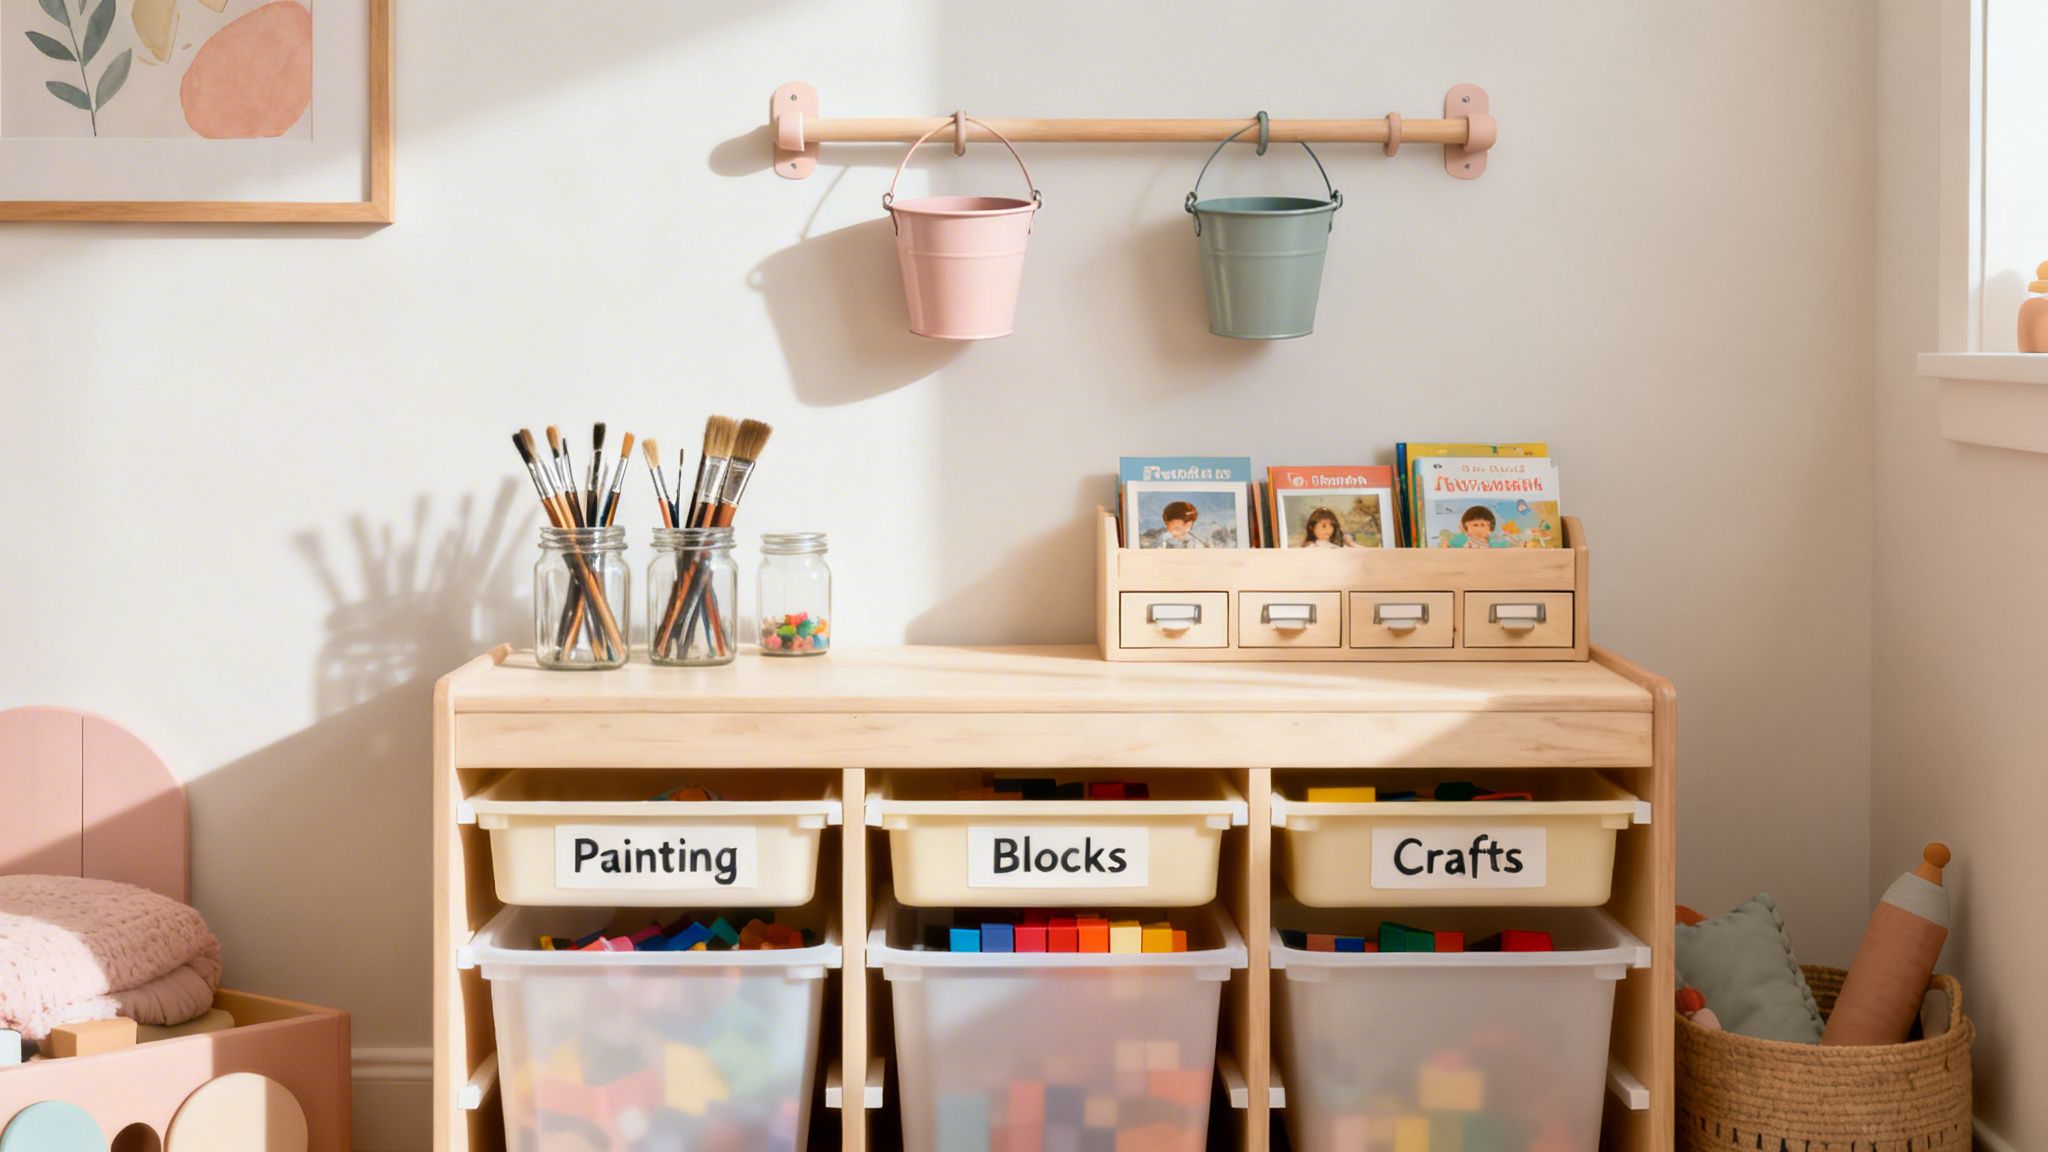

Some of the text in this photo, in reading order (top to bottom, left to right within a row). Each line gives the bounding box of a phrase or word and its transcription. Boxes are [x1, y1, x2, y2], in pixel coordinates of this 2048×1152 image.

[574, 836, 739, 886] Painting
[993, 835, 1127, 875] Blocks
[1394, 833, 1524, 879] Crafts
